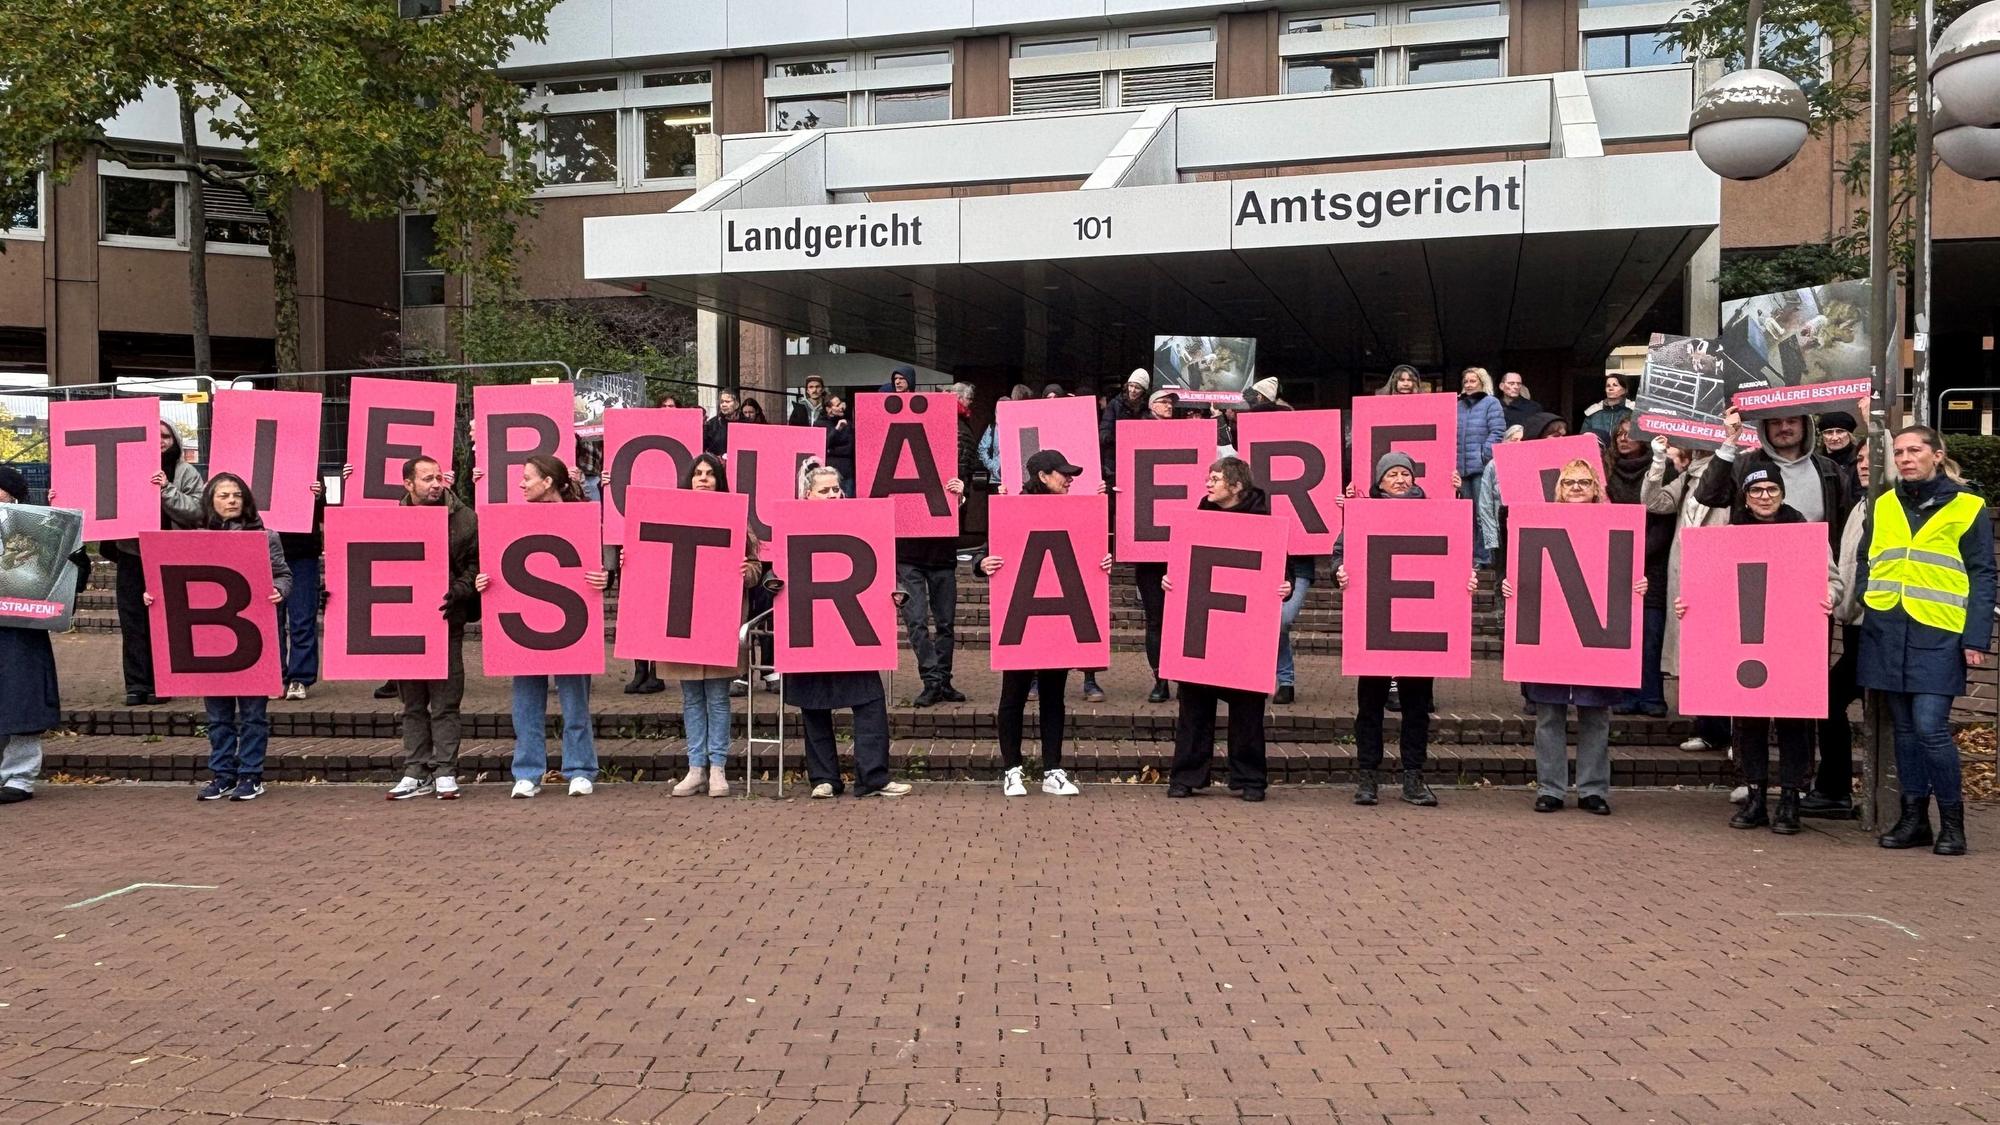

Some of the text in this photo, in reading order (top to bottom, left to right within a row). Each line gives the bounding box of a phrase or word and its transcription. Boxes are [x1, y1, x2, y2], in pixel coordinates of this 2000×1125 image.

[1236, 176, 1520, 229] Amtsgericht
[728, 213, 922, 258] Landgericht
[1074, 216, 1112, 240] 101
[1738, 389, 1810, 407] TIERQUÄLEREI
[1646, 418, 1713, 437] TIERQUÄLEREI
[0, 600, 55, 615] STRAFEN!
